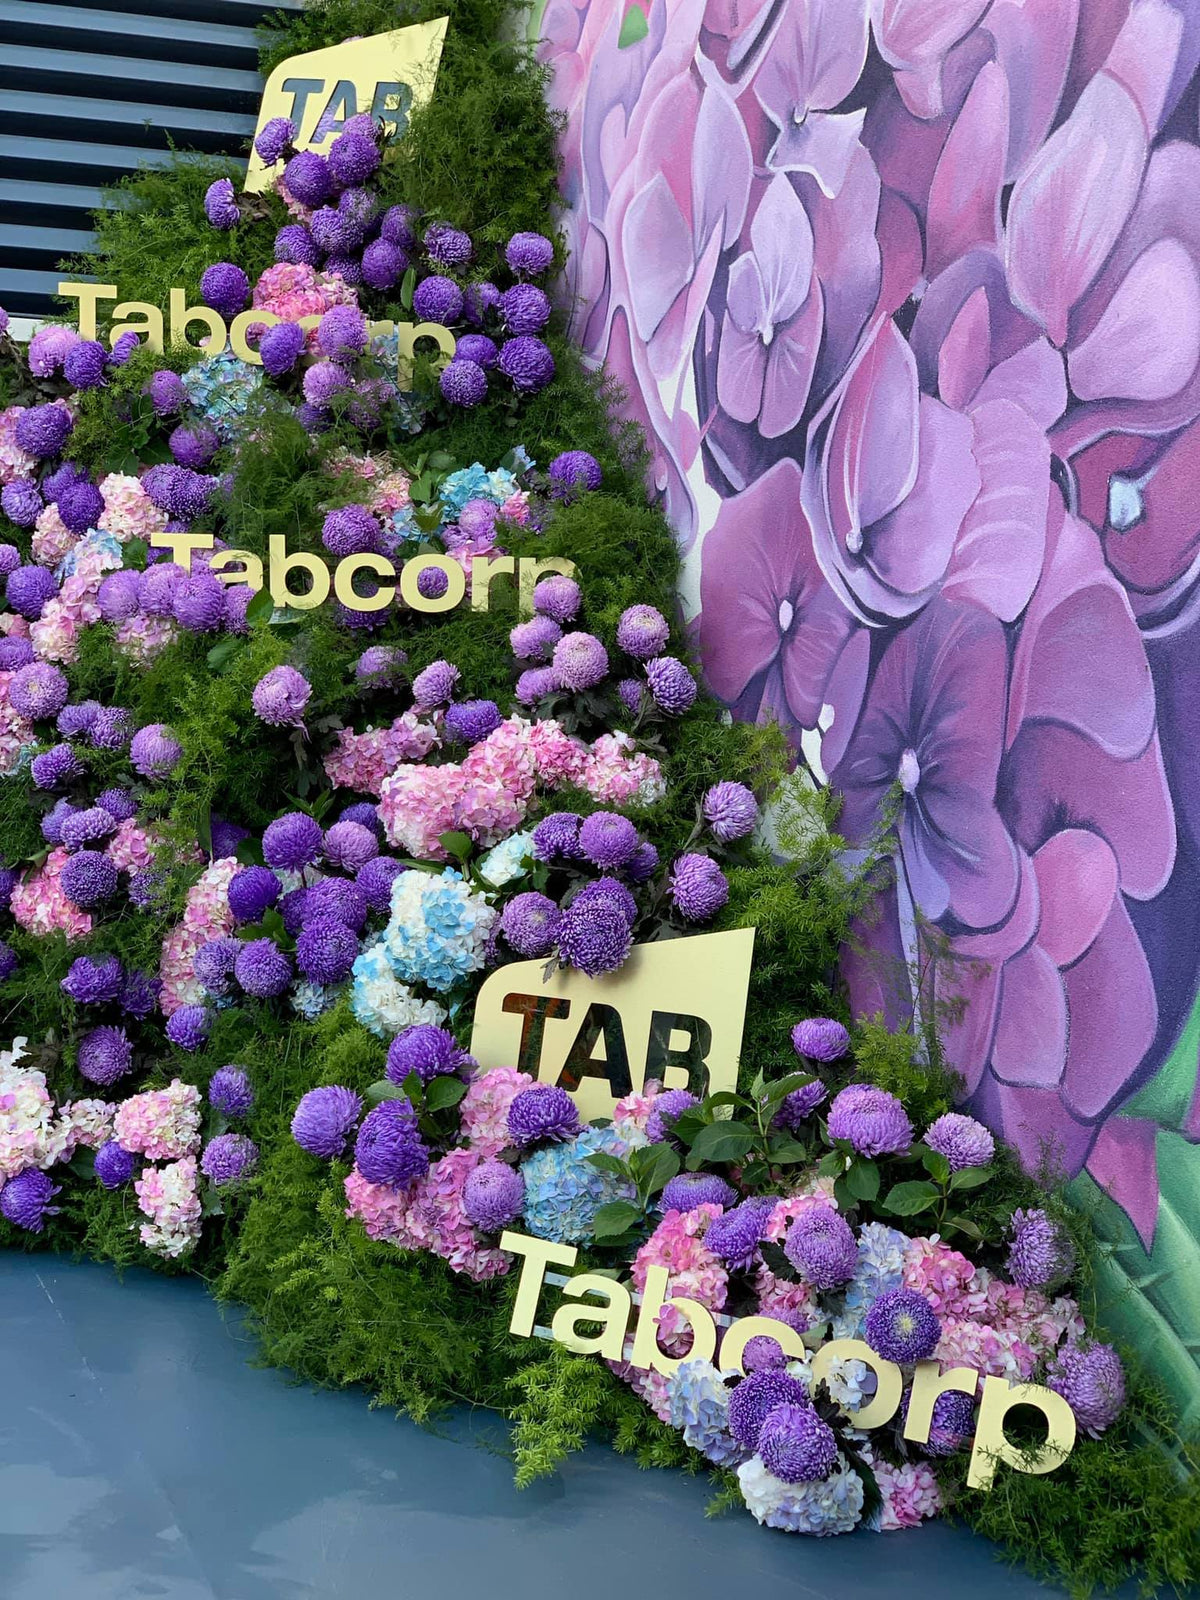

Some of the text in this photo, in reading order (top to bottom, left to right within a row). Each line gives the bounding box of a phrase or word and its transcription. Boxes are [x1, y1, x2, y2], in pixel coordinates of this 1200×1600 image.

[281, 78, 413, 147] TAB
[502, 993, 712, 1100] TAB
[500, 1231, 1076, 1491] Tabcorp
